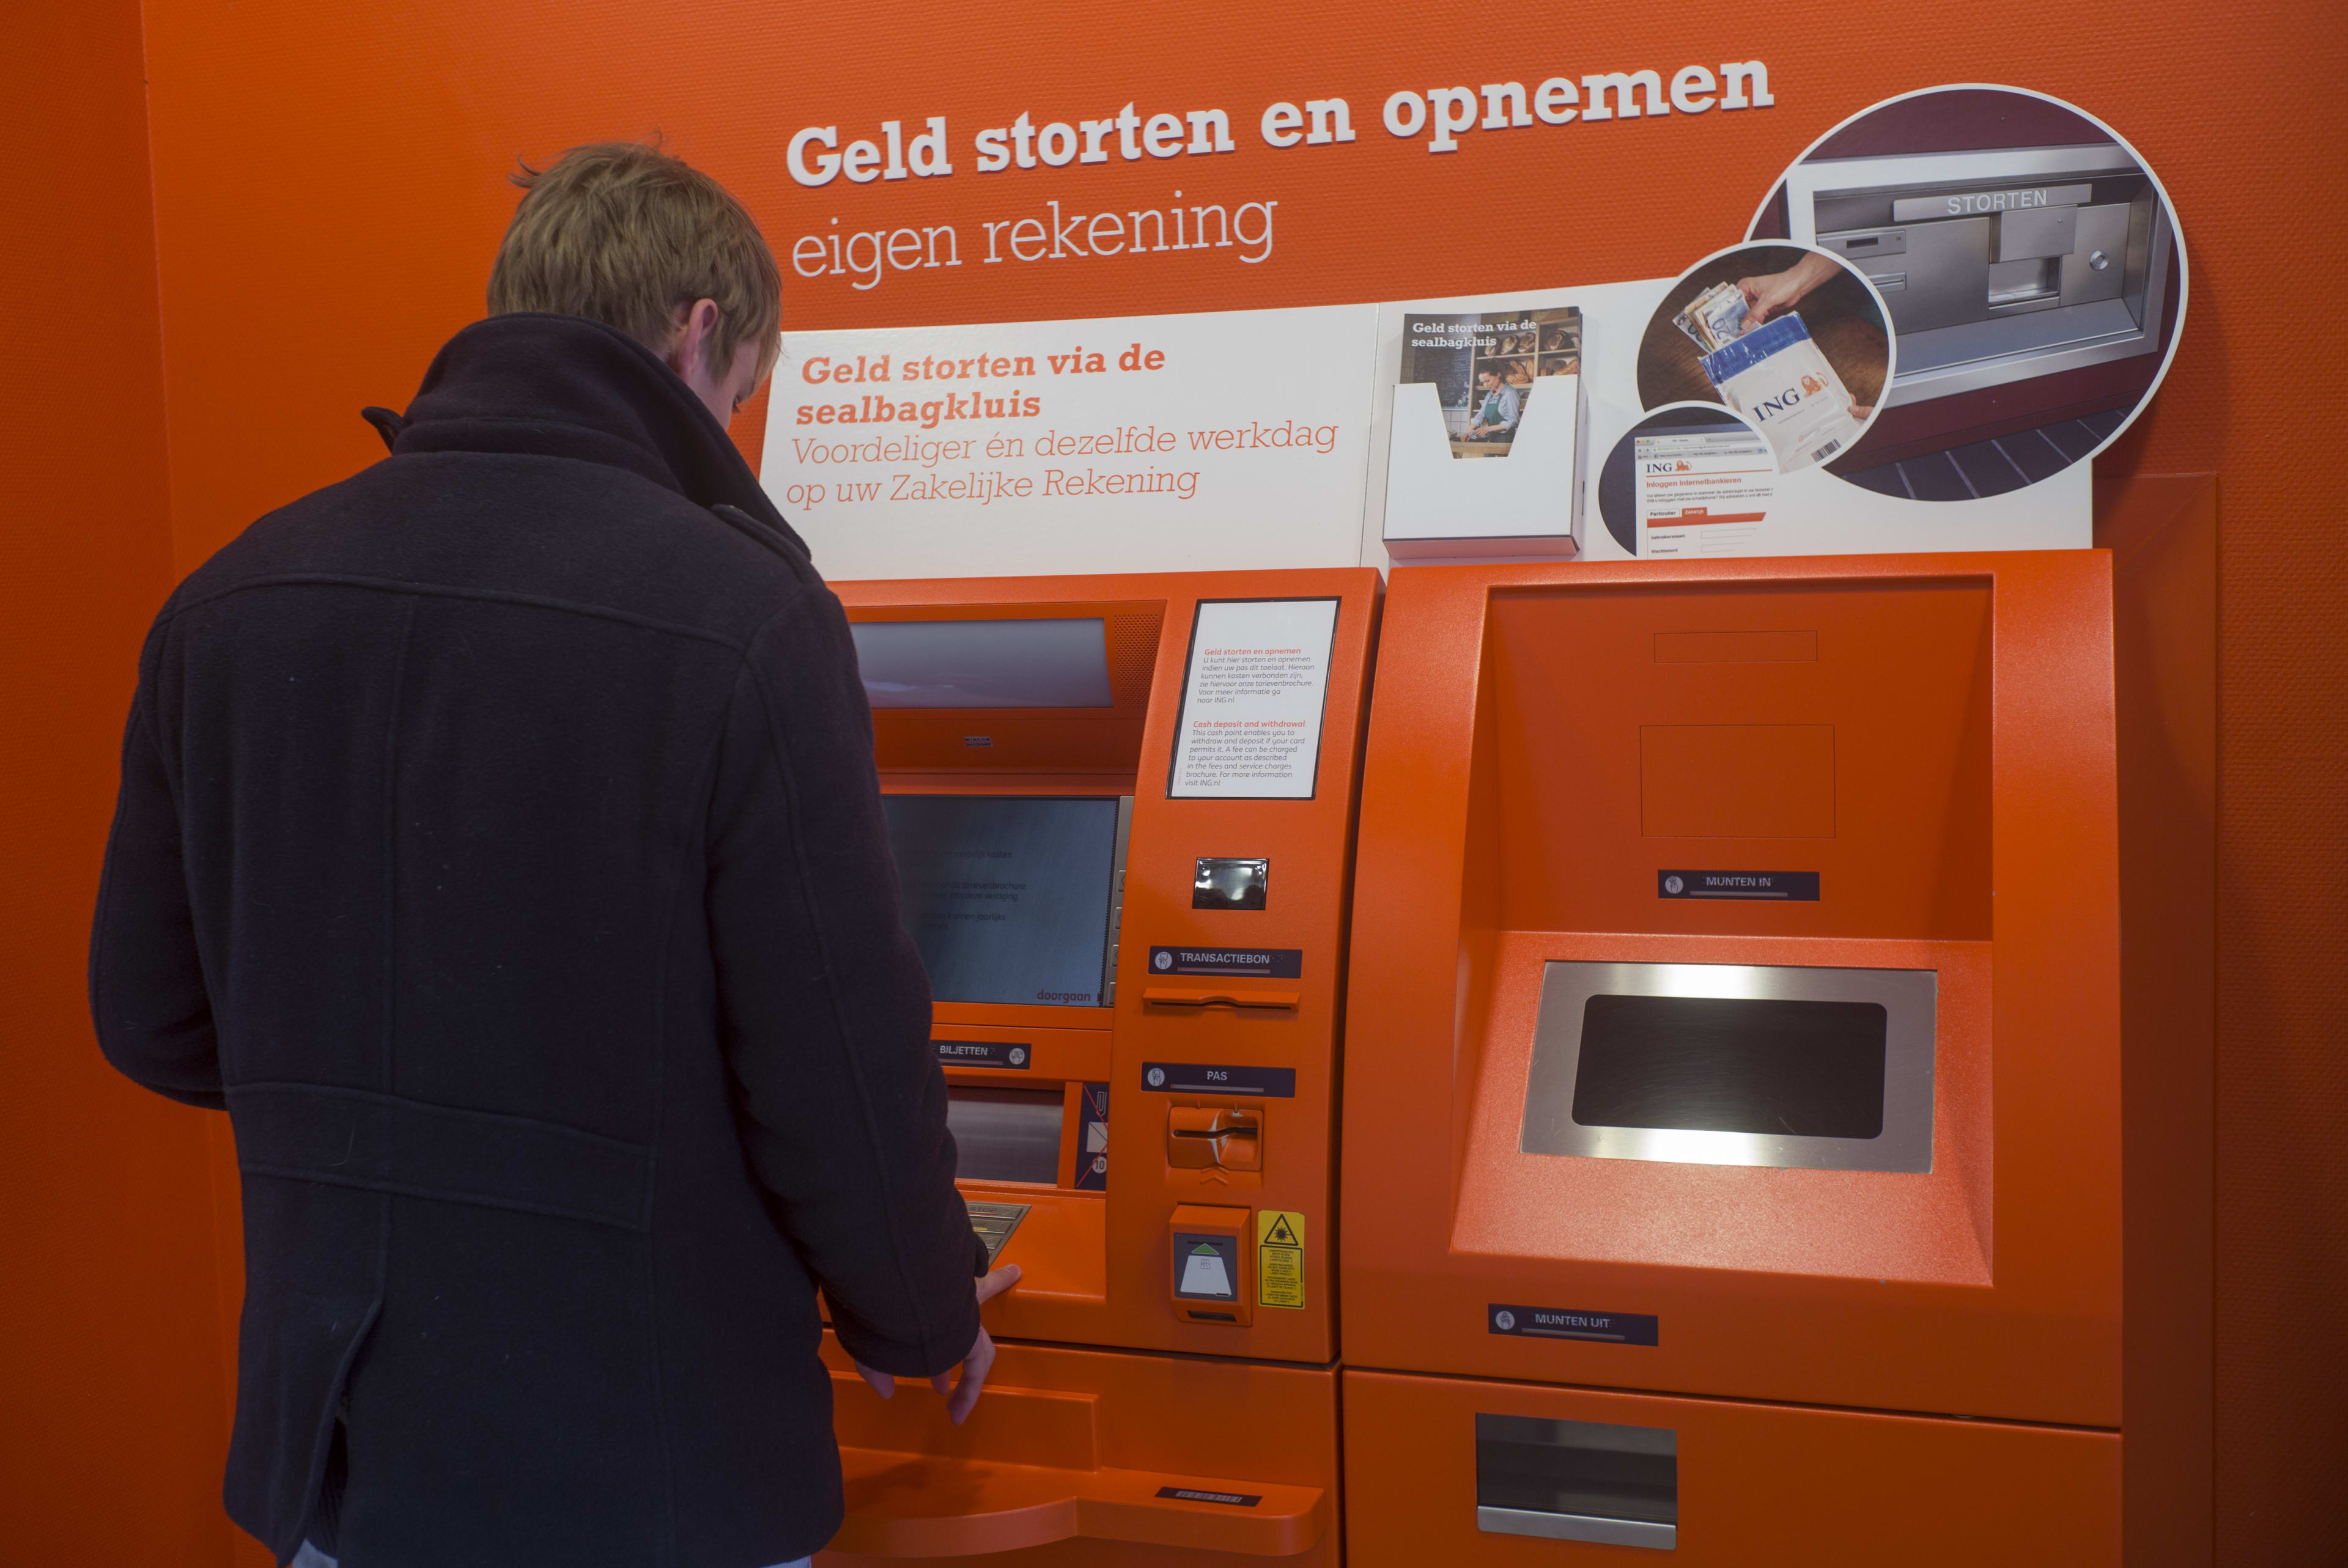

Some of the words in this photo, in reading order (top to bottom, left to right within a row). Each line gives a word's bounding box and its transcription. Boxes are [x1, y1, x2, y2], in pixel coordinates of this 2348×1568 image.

[786, 117, 953, 187] Geld
[975, 101, 1235, 172] storten
[1260, 97, 1356, 148] en
[1383, 59, 1775, 153] opnemen
[1946, 189, 2048, 216] STORTEN
[792, 218, 962, 290] eigen
[983, 190, 1278, 264] rekening
[1412, 323, 1444, 333] Geld
[1448, 324, 1494, 333] storten
[1496, 321, 1517, 331] via
[1520, 320, 1537, 329] de
[1412, 336, 1496, 348] sealbagkluis
[802, 355, 890, 384] Geld
[903, 355, 1035, 380] storten
[1047, 346, 1106, 375] via
[1118, 343, 1165, 371] de
[797, 391, 1039, 429] sealbagkluis
[1752, 387, 1801, 422] ING
[793, 435, 975, 468] Voordeliger
[986, 432, 1024, 458] én
[1035, 426, 1176, 456] dezelfde
[1189, 421, 1338, 454] werkdag
[1646, 462, 1672, 473] ING
[785, 483, 826, 511] op
[837, 483, 882, 502] uw
[890, 472, 1033, 505] Zakelijke
[1043, 466, 1198, 499] Rekening
[1213, 720, 1242, 729] deposit
[1706, 877, 1755, 886] MUNTEN
[1759, 877, 1771, 886] IN
[984, 893, 1019, 902] vestiging
[1180, 952, 1269, 963] TRANSACTIEBON
[1037, 990, 1091, 1003] doorgaan
[940, 1045, 988, 1055] BILJETTEN
[1207, 1071, 1227, 1081] PAS
[1535, 1314, 1587, 1326] MUNTEN
[1590, 1318, 1610, 1328] UIT
